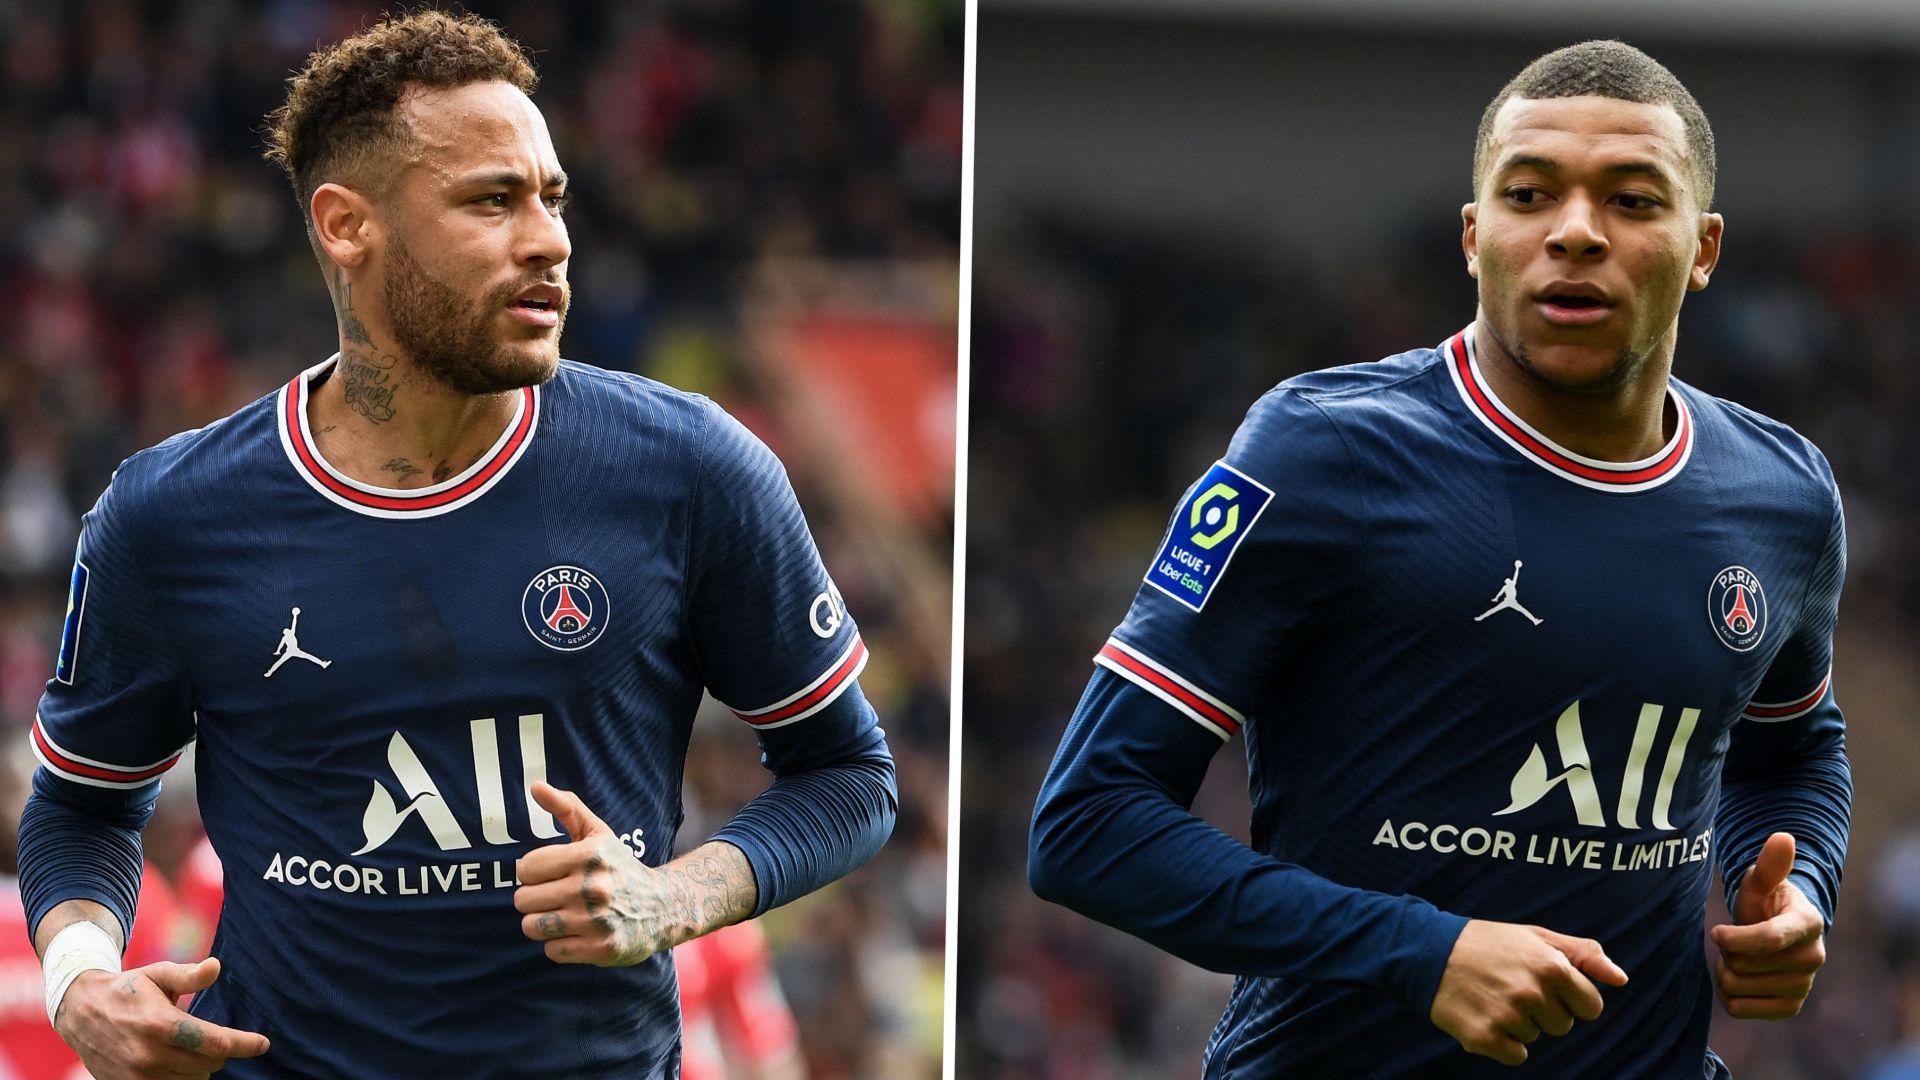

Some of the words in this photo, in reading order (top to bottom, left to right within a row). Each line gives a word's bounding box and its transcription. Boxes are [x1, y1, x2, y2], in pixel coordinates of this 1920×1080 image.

[1159, 560, 1181, 581] Uber
[1180, 573, 1203, 594] Eats
[1171, 546, 1203, 571] LIGUE
[1204, 565, 1211, 576] 1
[534, 570, 592, 593] PARIS
[1718, 570, 1758, 594] PARIS
[1372, 819, 1517, 860] ACCOR
[1526, 834, 1605, 870] LIVE
[263, 852, 388, 896] ACCOR
[398, 862, 482, 895] LIVE
